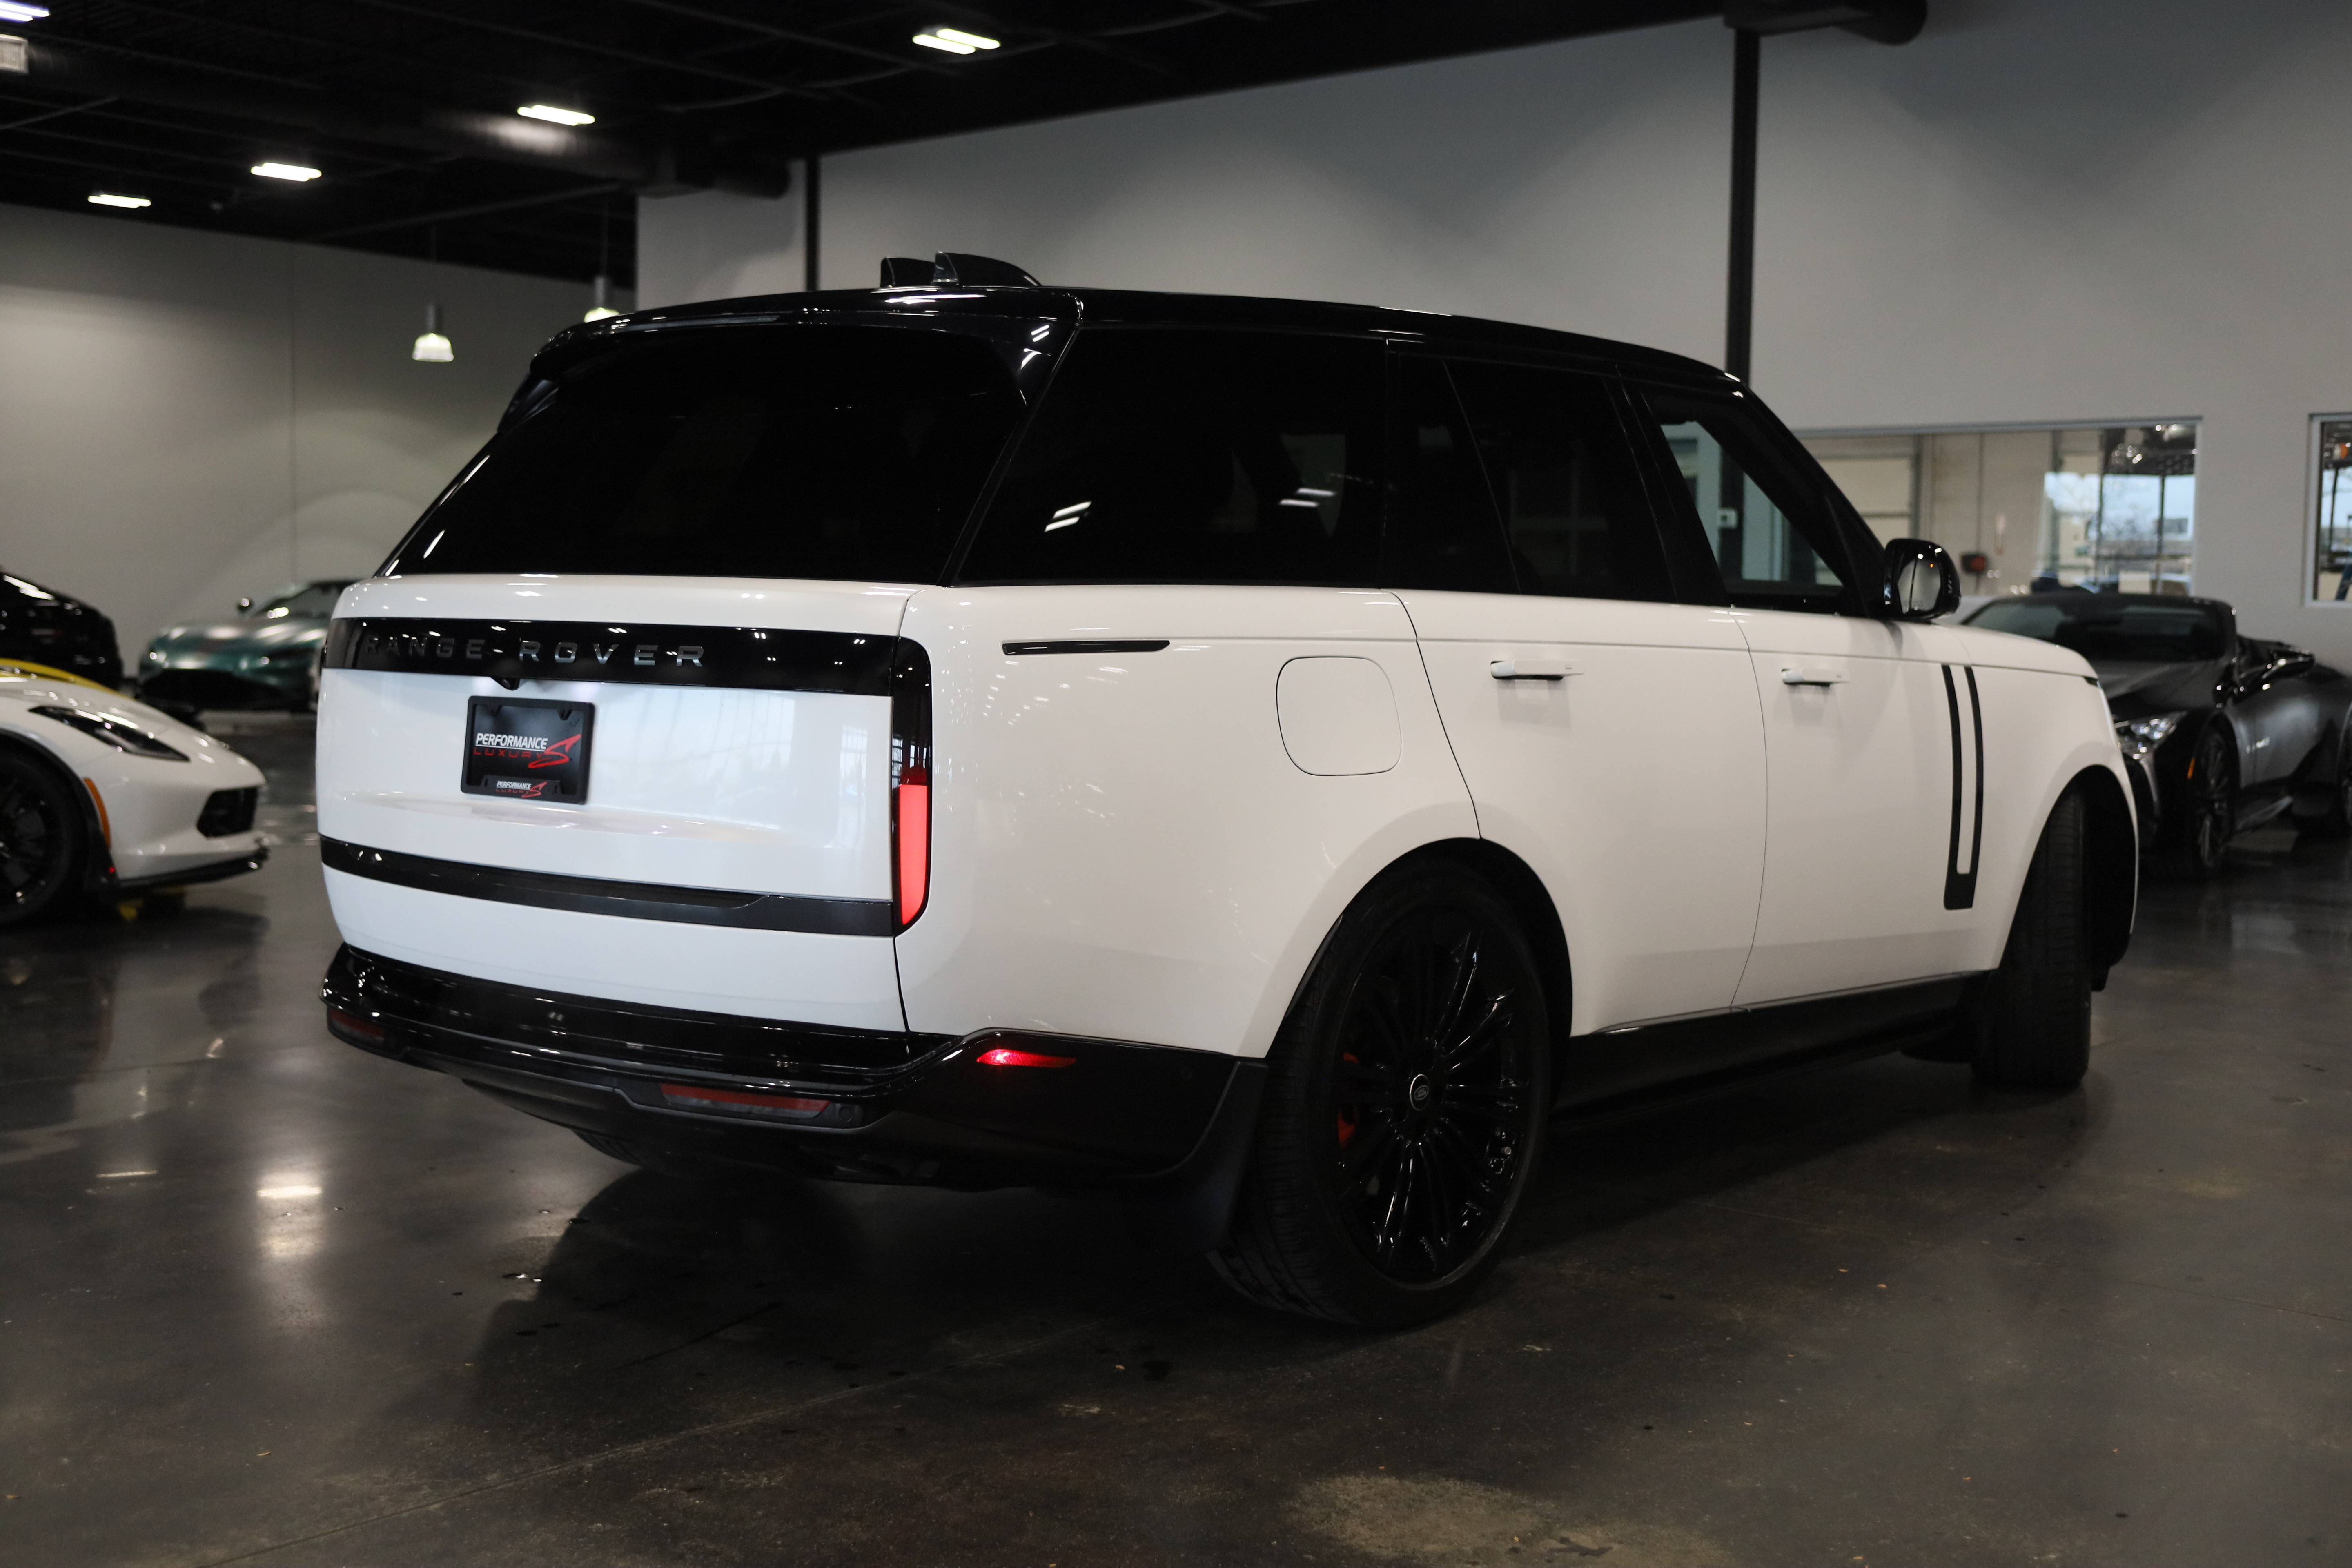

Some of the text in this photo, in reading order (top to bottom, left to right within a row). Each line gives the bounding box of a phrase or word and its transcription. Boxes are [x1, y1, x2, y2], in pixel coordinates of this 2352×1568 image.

[365, 635, 704, 667] RANGE ROVER
[476, 733, 548, 750] PERFORMANCE
[497, 780, 532, 790] PERFORMANCE
